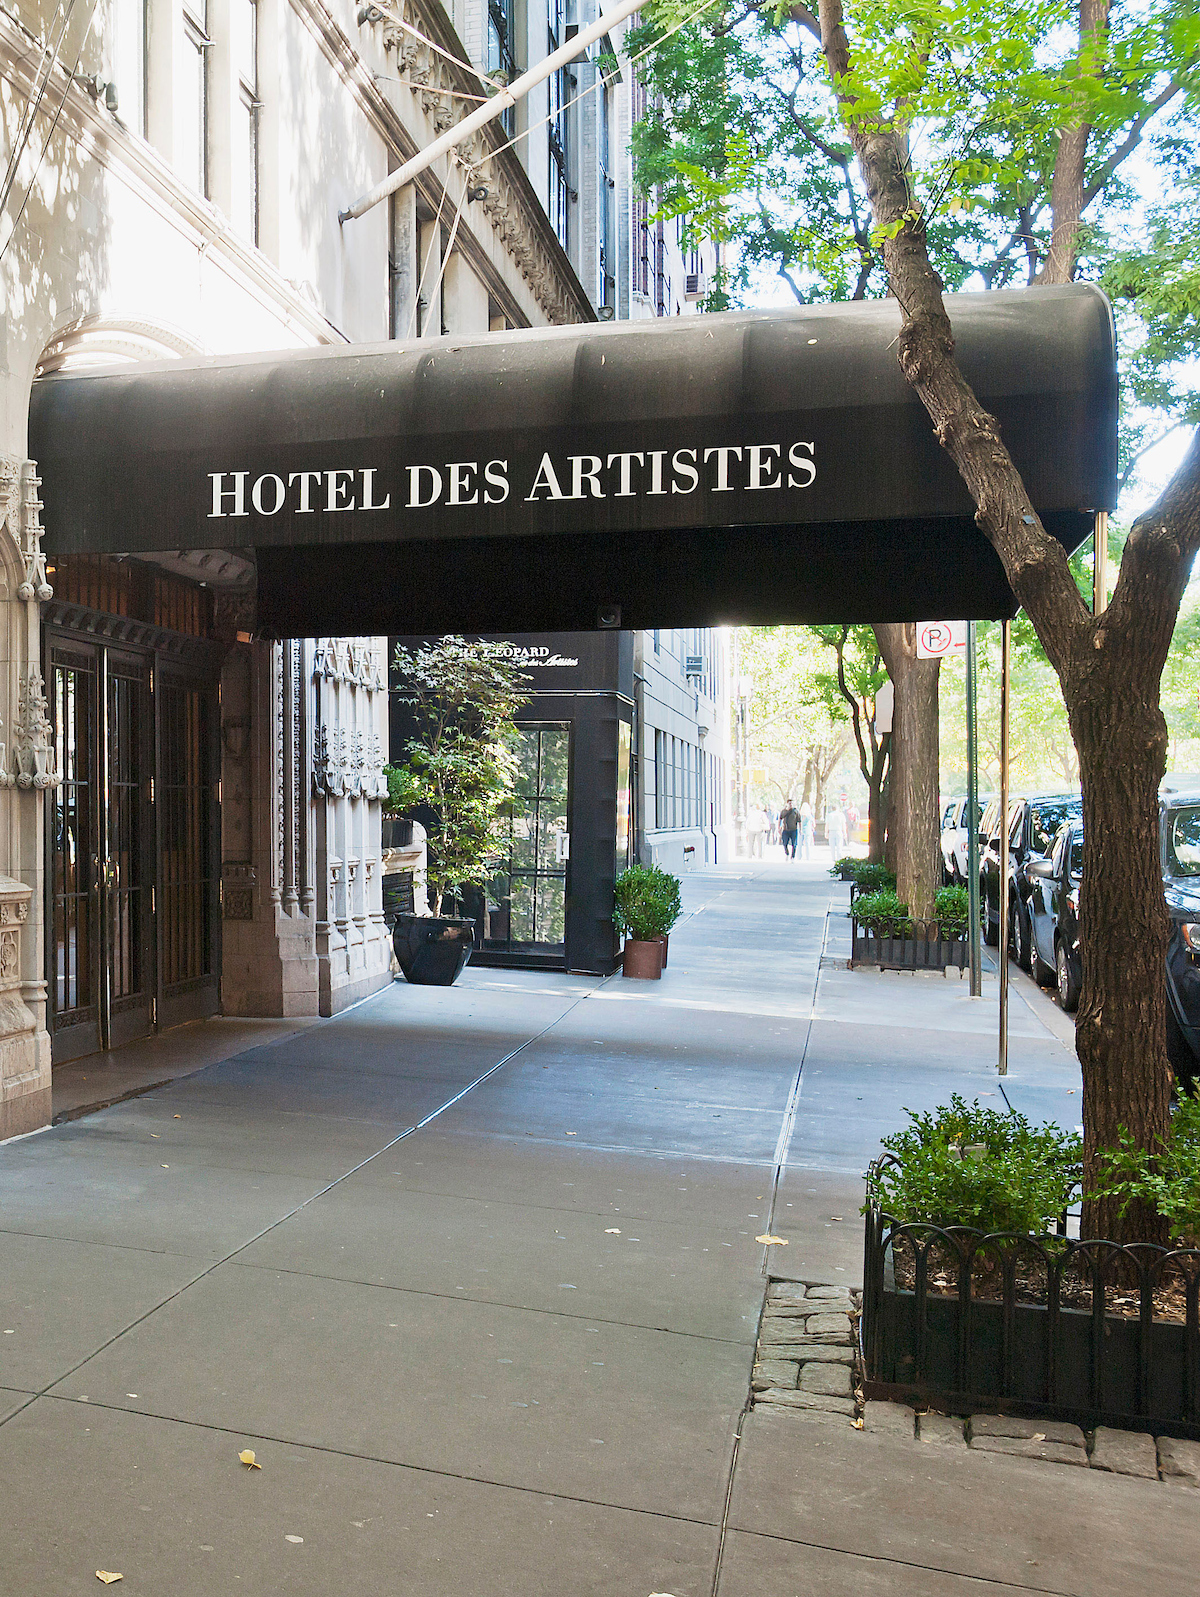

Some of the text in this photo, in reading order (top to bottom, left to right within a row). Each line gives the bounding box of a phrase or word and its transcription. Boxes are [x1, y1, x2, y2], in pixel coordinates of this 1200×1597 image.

[206, 441, 817, 518] HOTEL DES ARTISTES
[483, 646, 550, 658] LEOPARD
